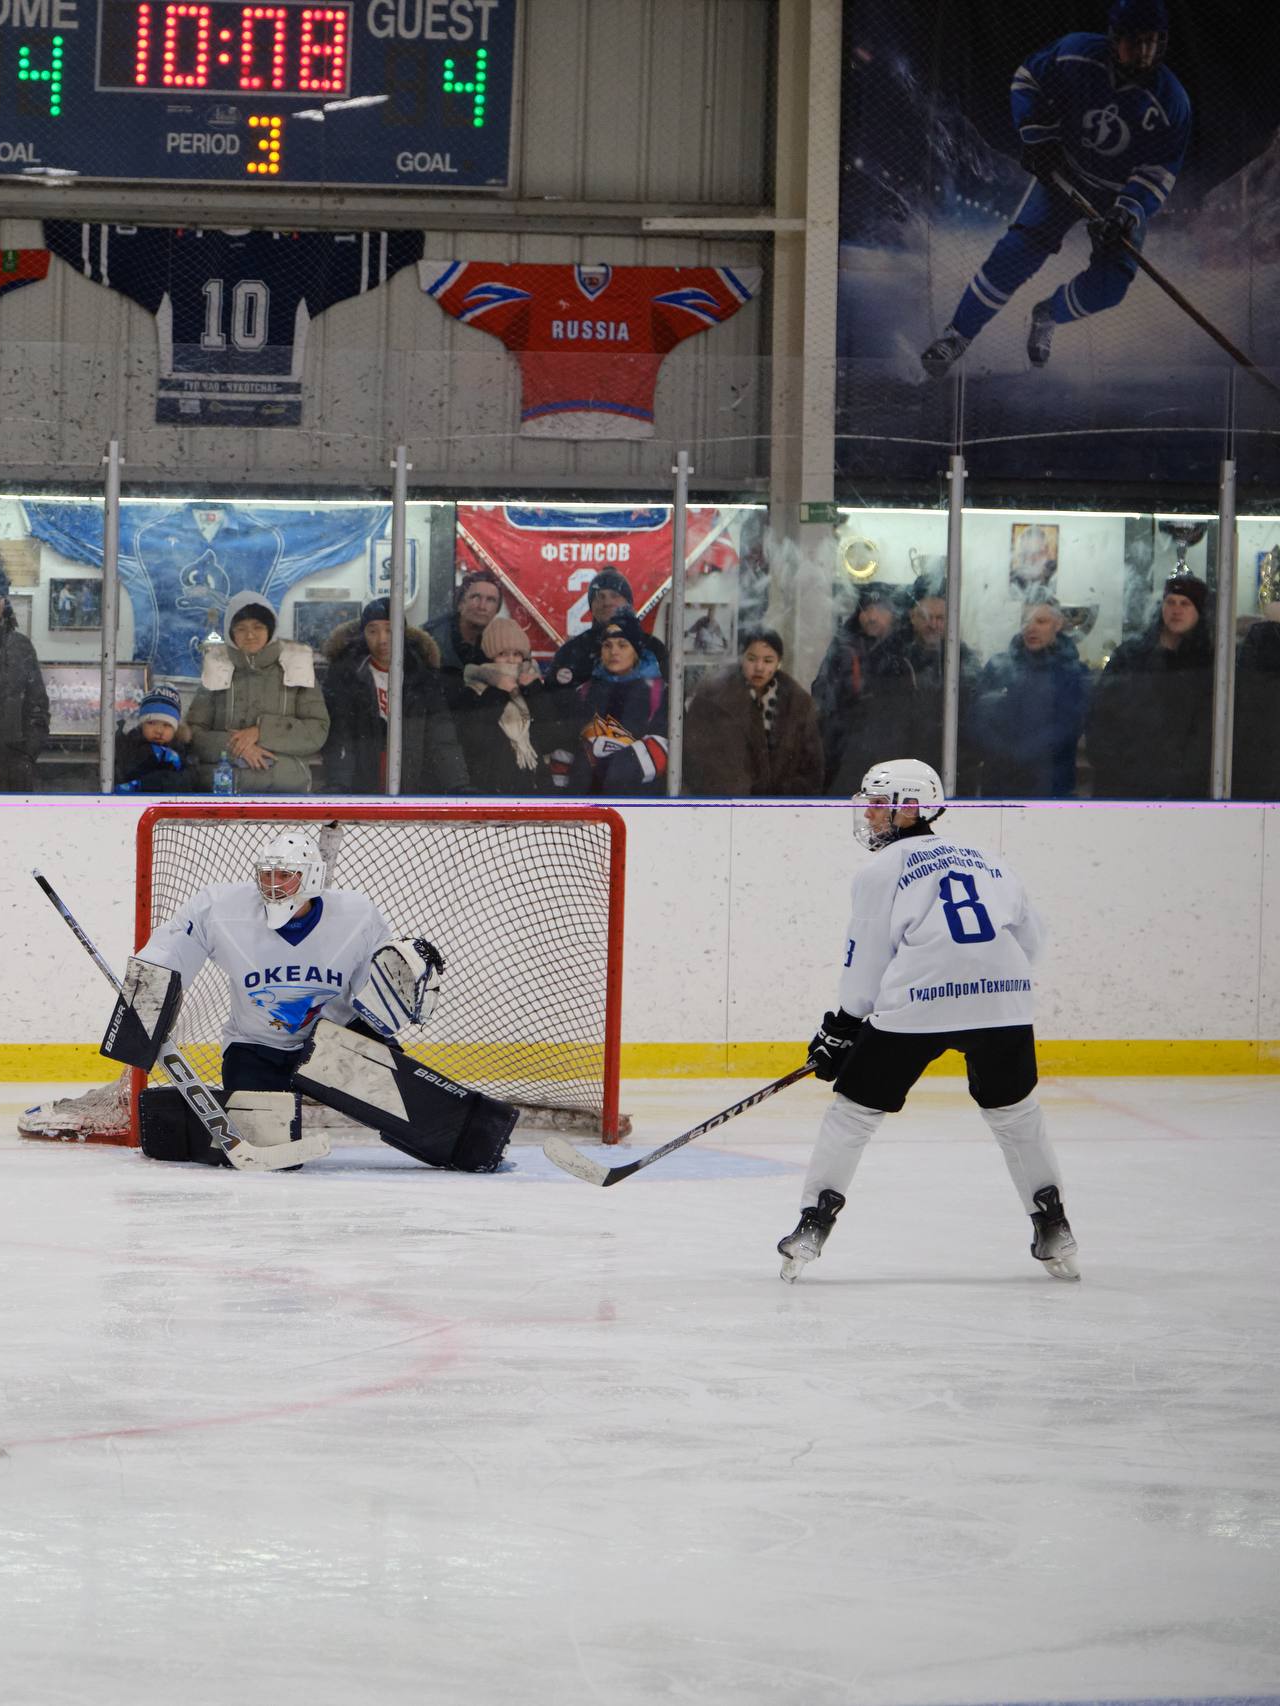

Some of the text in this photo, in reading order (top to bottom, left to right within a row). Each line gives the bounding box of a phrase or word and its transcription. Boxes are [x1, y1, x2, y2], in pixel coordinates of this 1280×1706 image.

[366, 0, 499, 42] GUEST
[134, 2, 348, 93] 10:08
[18, 35, 64, 117] 4
[442, 48, 488, 129] 4
[166, 132, 241, 156] PERIOD
[246, 115, 283, 174] 3
[395, 151, 459, 173] GOAL
[200, 278, 270, 351] 10
[550, 319, 630, 343] RUSSIA
[540, 542, 631, 562] ФЕТИСОВ
[938, 869, 997, 944] 8
[244, 964, 344, 989] ОКЕАН
[104, 1004, 128, 1053] BAUER
[162, 1053, 242, 1153] CCM
[412, 1067, 470, 1100] BAUER
